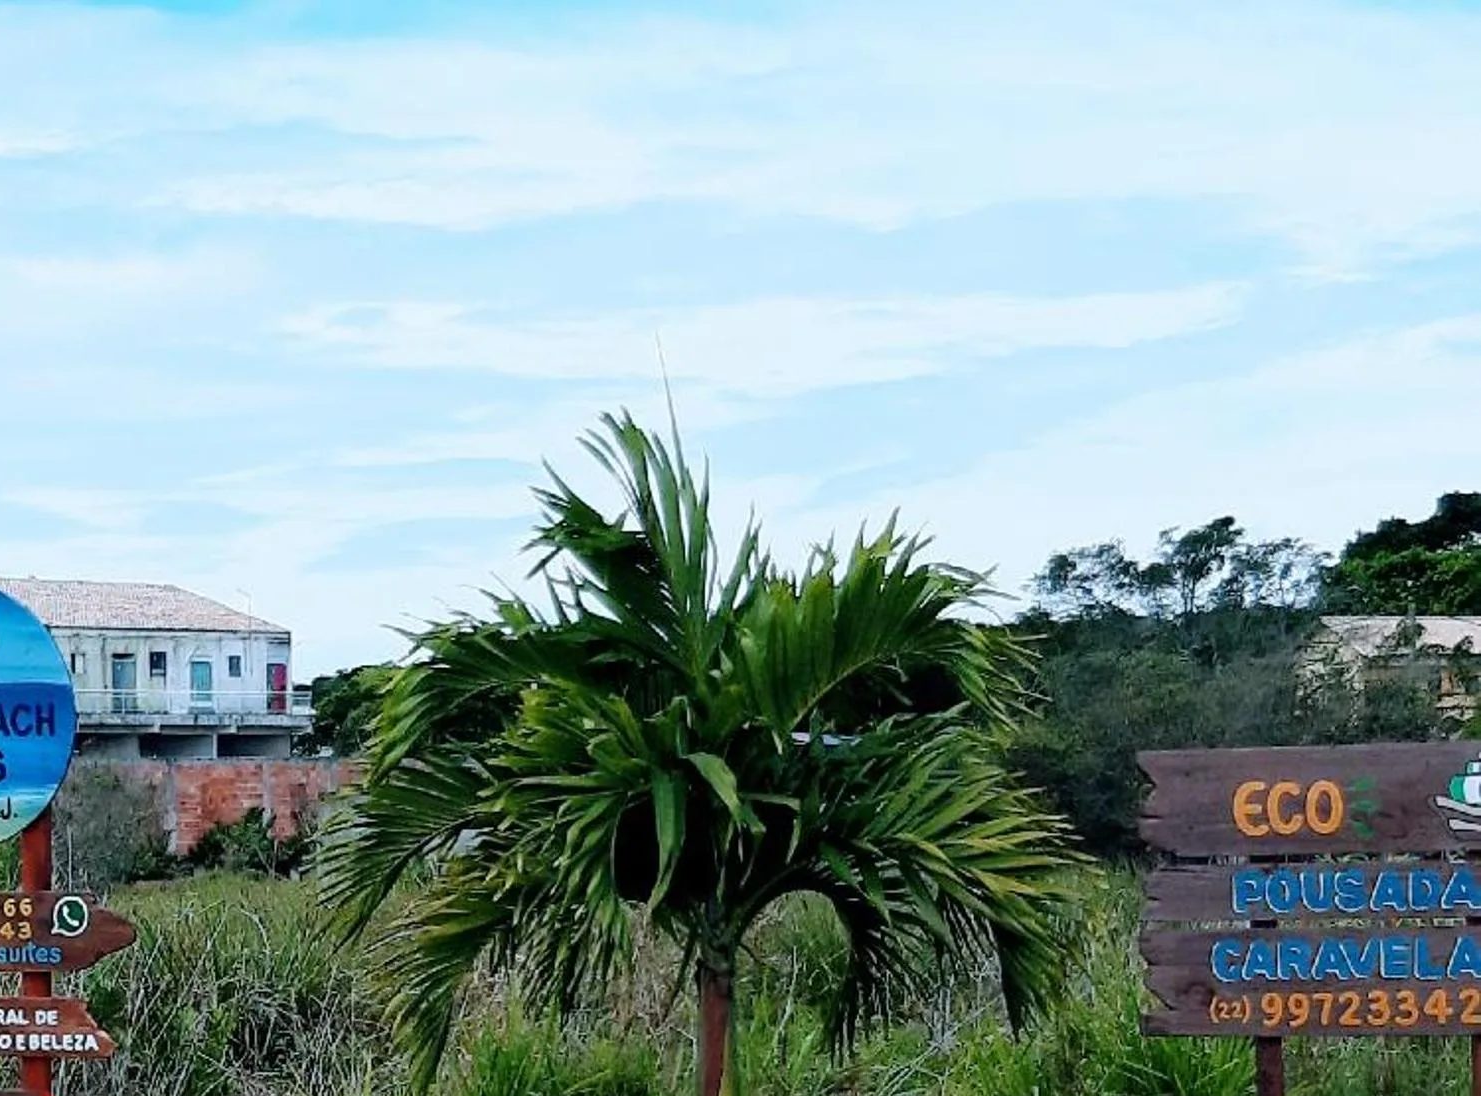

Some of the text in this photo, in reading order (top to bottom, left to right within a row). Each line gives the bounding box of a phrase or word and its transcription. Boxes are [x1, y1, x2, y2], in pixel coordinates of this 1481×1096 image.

[1232, 779, 1345, 838] ECO
[1230, 867, 1481, 914] POUSADA
[35, 1009, 58, 1025] DE
[1209, 994, 1252, 1025] (22)
[15, 1034, 26, 1051] E
[28, 1034, 100, 1051] BELEZA
